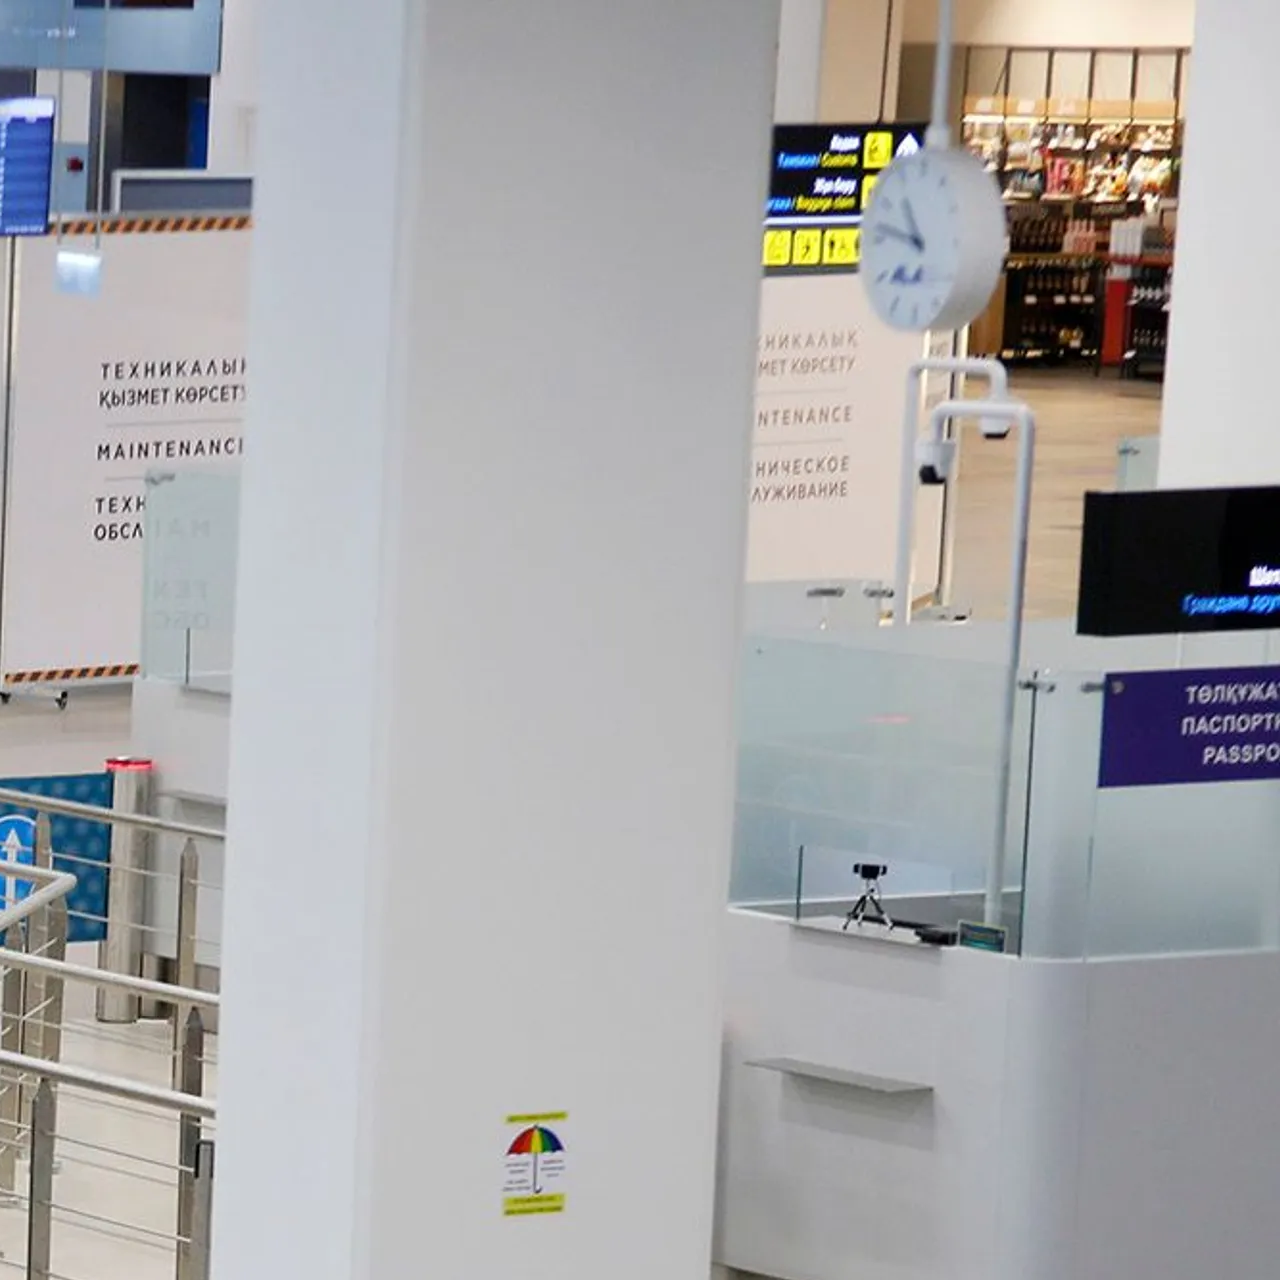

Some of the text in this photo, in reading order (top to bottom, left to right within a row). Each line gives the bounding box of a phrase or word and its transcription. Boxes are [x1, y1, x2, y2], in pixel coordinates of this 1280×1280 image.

[99, 388, 169, 410] ҚЫЗМЕТ
[758, 405, 852, 427] NTENANCE
[97, 437, 243, 460] MAINTENANC
[756, 455, 850, 477] НИЧЕСКОЕ
[752, 481, 848, 503] ЛУЖИВАНИЕ
